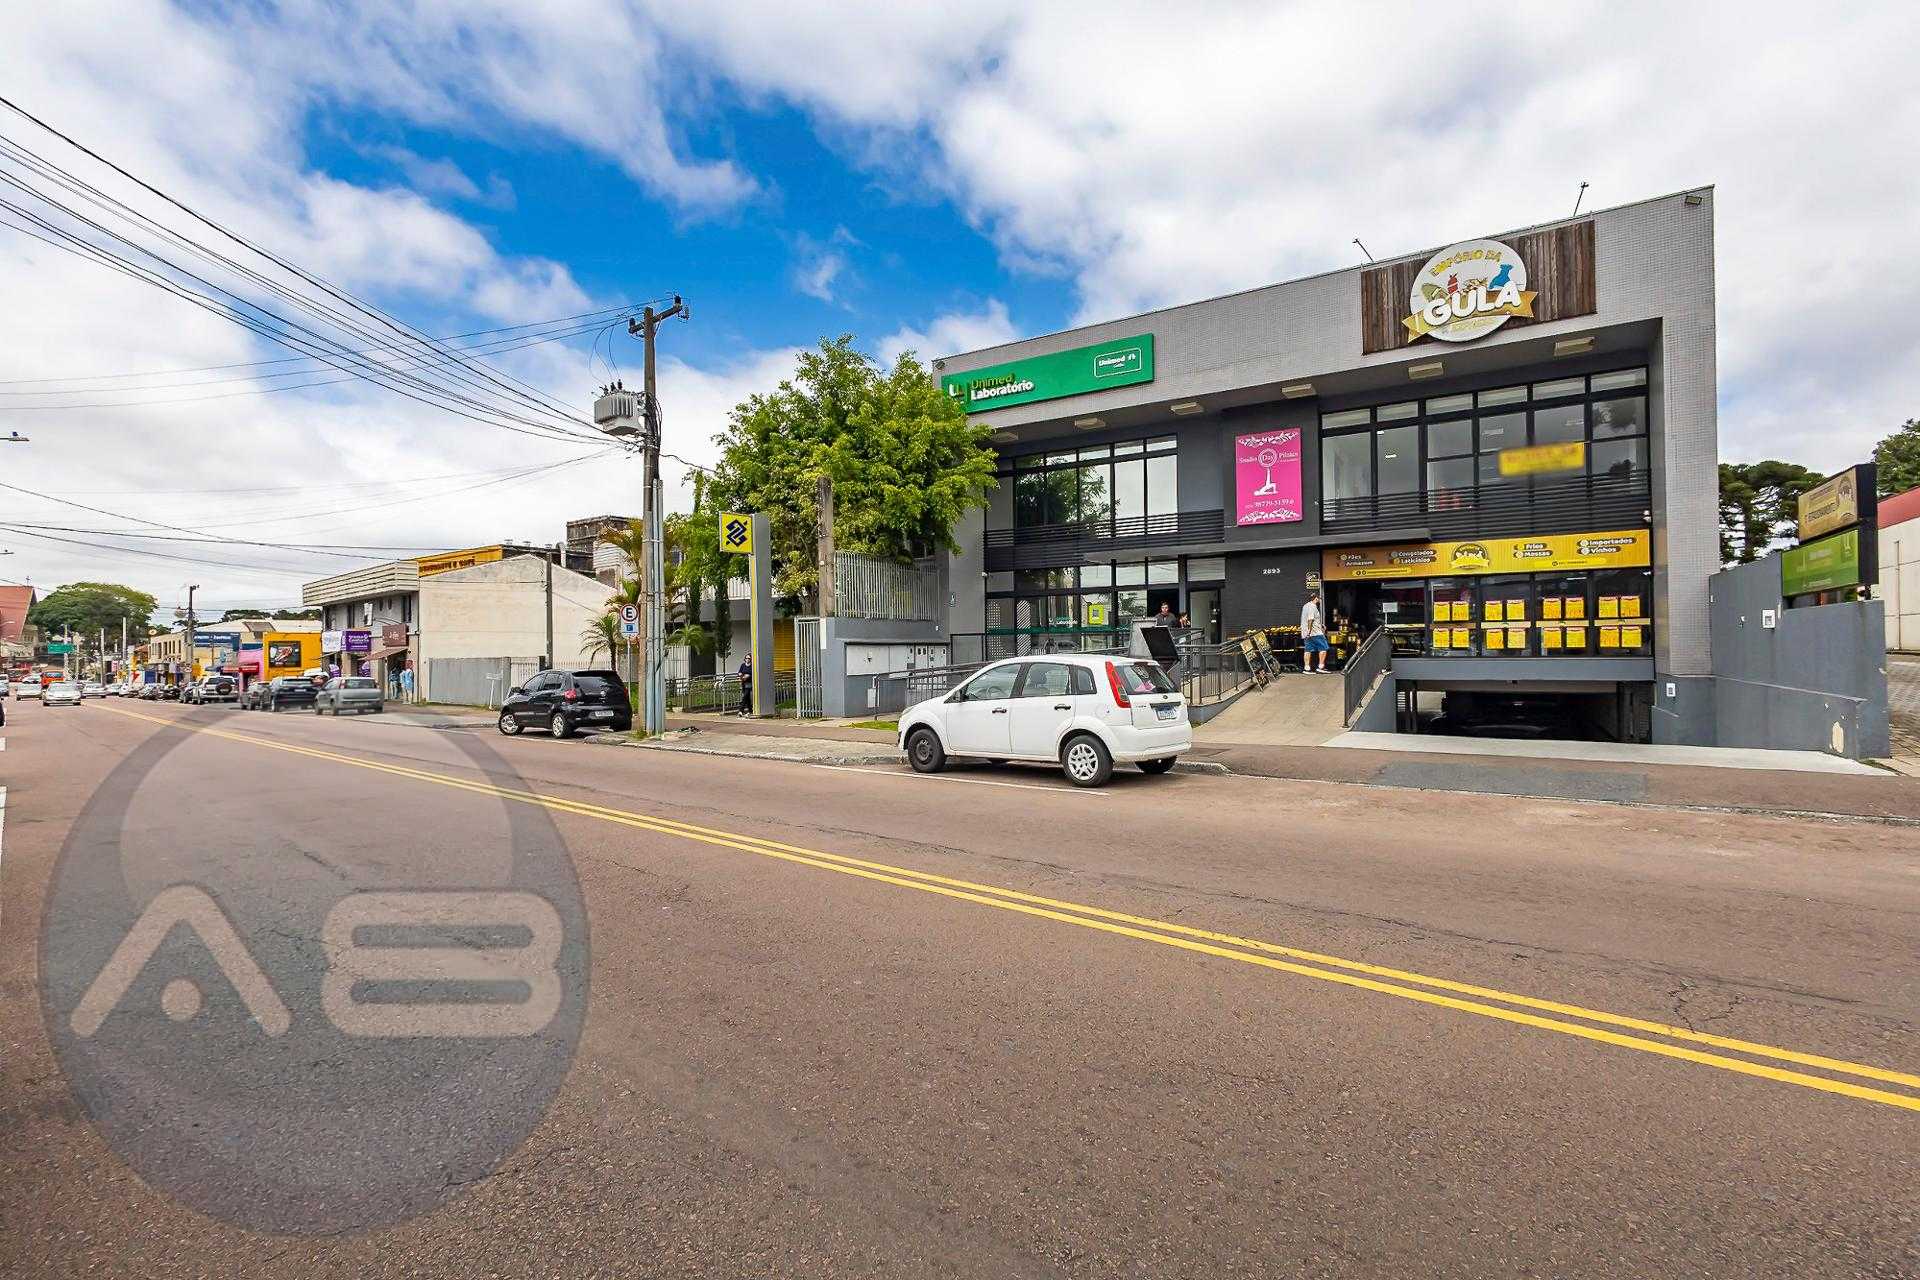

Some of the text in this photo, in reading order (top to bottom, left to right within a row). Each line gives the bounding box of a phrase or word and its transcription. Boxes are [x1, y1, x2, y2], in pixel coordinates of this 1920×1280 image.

[1423, 280, 1521, 326] GULA
[971, 373, 1014, 389] Unimed
[970, 379, 1034, 401] Laboratório
[1589, 537, 1634, 547] Importados
[1591, 547, 1617, 555] Vinhos
[625, 607, 634, 619] E
